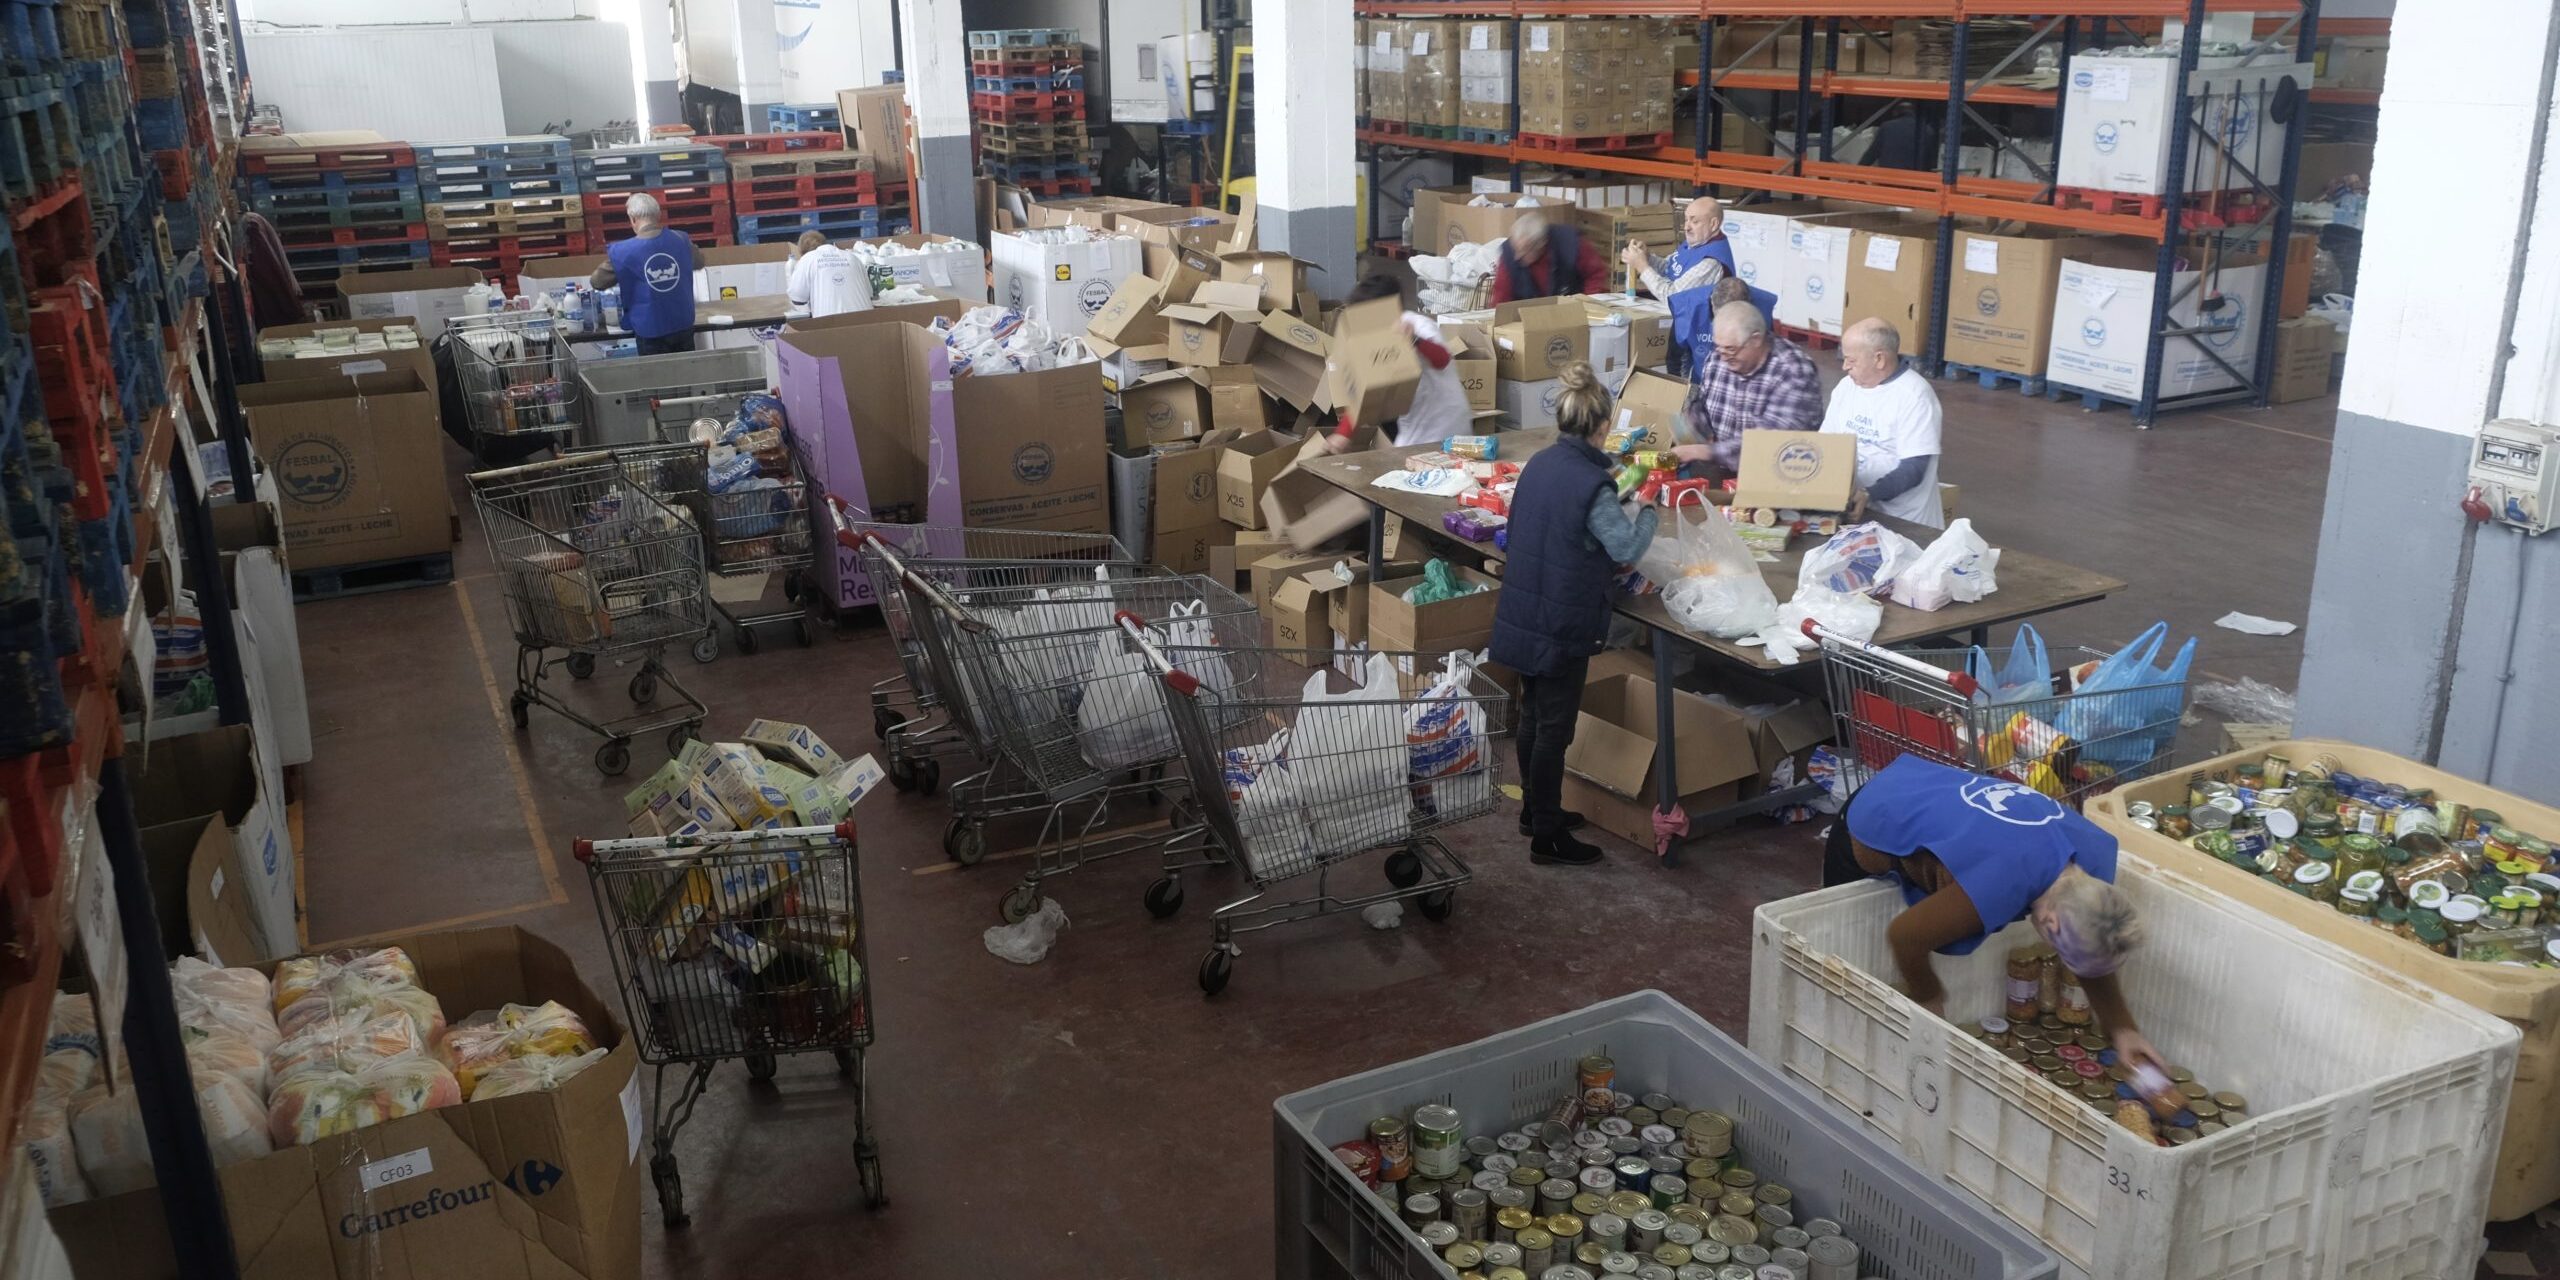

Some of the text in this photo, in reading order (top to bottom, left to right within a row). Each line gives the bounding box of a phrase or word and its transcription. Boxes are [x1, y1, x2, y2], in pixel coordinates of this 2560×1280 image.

[1646, 335, 1666, 348] X25
[286, 454, 336, 467] FESBAL
[968, 492, 1096, 517] CONSERVAS ACEITE LECHE
[1227, 493, 1245, 508] X25
[318, 524, 353, 536] ACEITE
[361, 519, 393, 531] LECHE
[1194, 537, 1204, 562] X25
[1280, 624, 1297, 642] X25
[379, 1164, 414, 1183] CF03
[2107, 1166, 2131, 1194] 33
[339, 1181, 494, 1239] Carrefour
